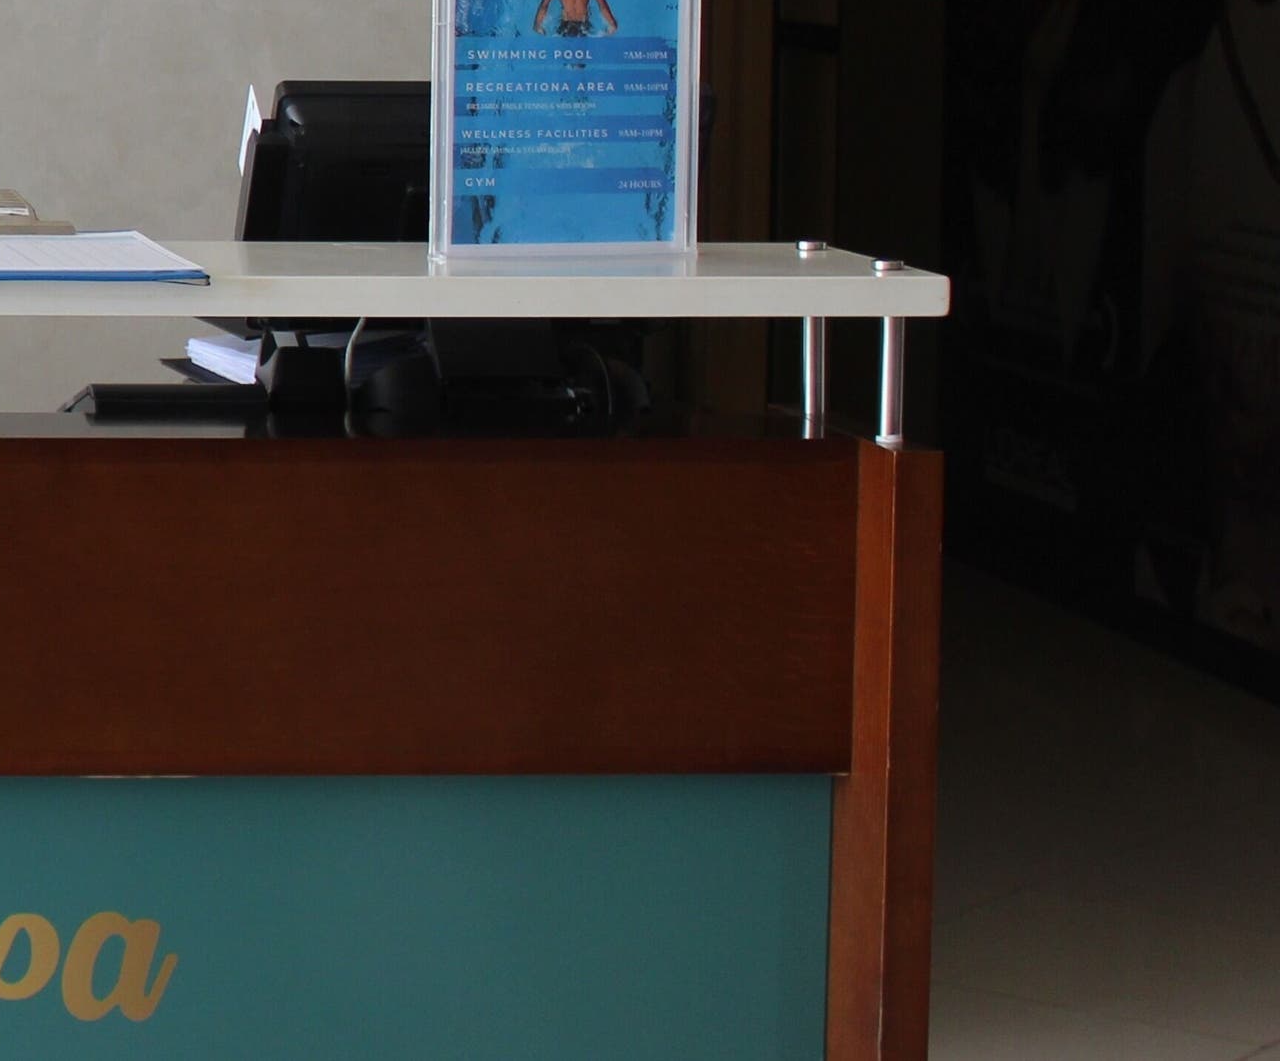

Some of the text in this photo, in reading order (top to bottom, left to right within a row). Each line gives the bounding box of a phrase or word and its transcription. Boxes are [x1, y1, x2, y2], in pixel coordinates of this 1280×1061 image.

[467, 49, 547, 60] SWIMMING
[554, 49, 593, 60] POOL
[576, 82, 616, 92] AREA
[461, 129, 531, 138] WELLNESS
[537, 129, 609, 138] FACILITIES
[465, 177, 496, 187] GYM
